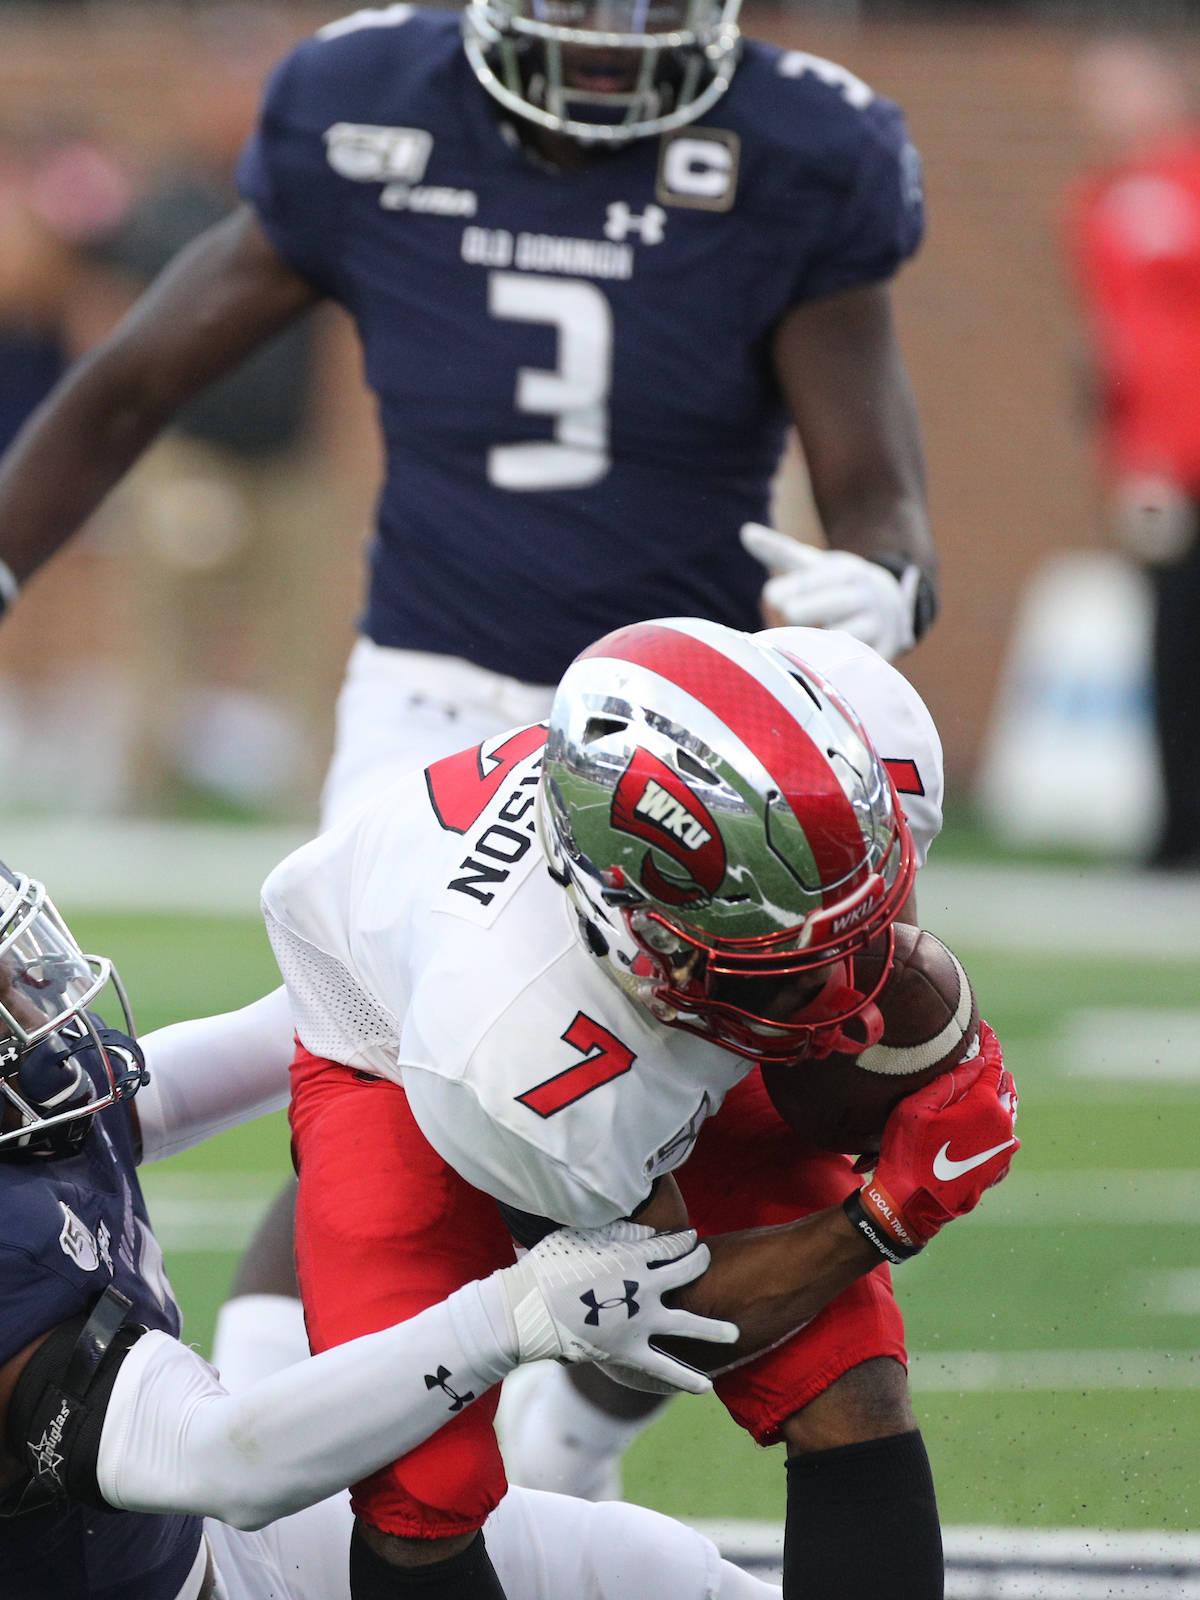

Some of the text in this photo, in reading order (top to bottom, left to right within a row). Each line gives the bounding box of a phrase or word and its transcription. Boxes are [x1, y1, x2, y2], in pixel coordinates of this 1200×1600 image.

[665, 138, 733, 197] C
[487, 271, 613, 491] 3
[635, 778, 712, 850] WKU
[513, 1010, 638, 1119] 7
[868, 1188, 894, 1220] LOCAL
